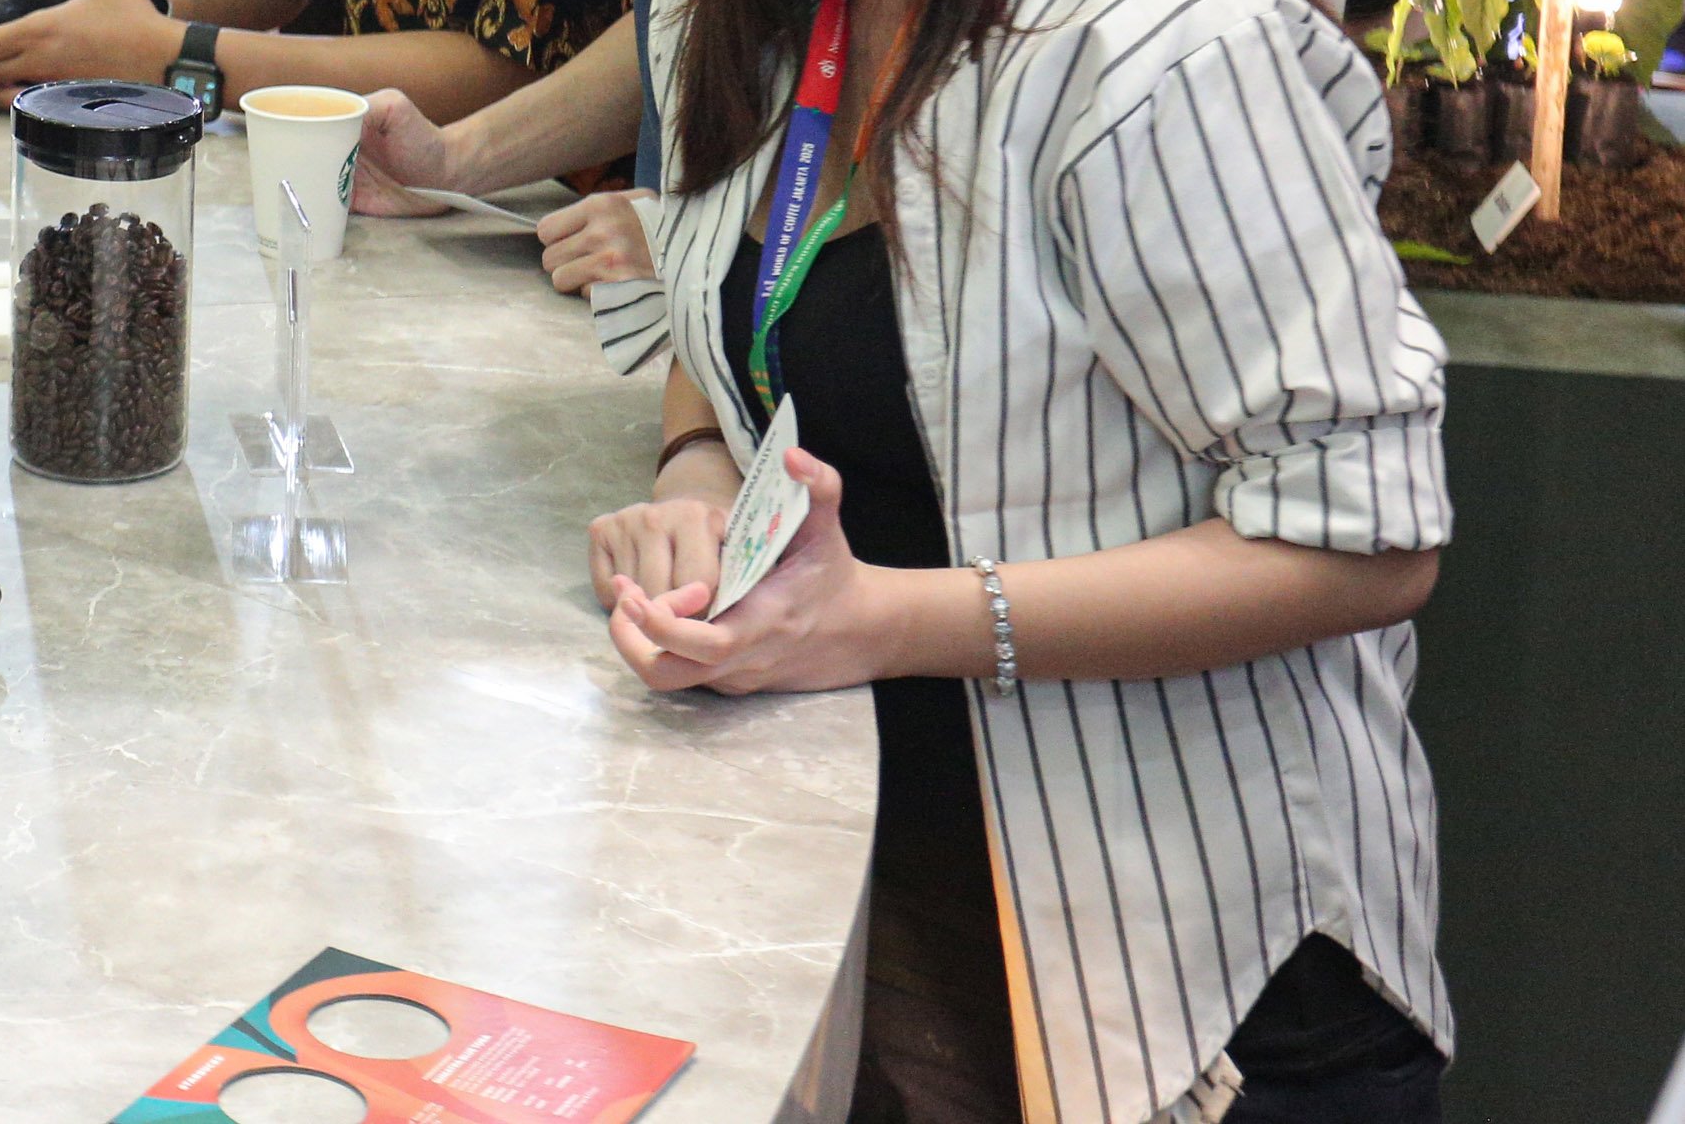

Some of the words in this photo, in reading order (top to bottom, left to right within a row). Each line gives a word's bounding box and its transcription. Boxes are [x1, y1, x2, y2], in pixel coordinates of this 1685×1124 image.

[791, 167, 811, 202] JAKARTA
[783, 202, 802, 233] COFFEE
[779, 233, 793, 247] OF
[771, 245, 789, 277] WORLD
